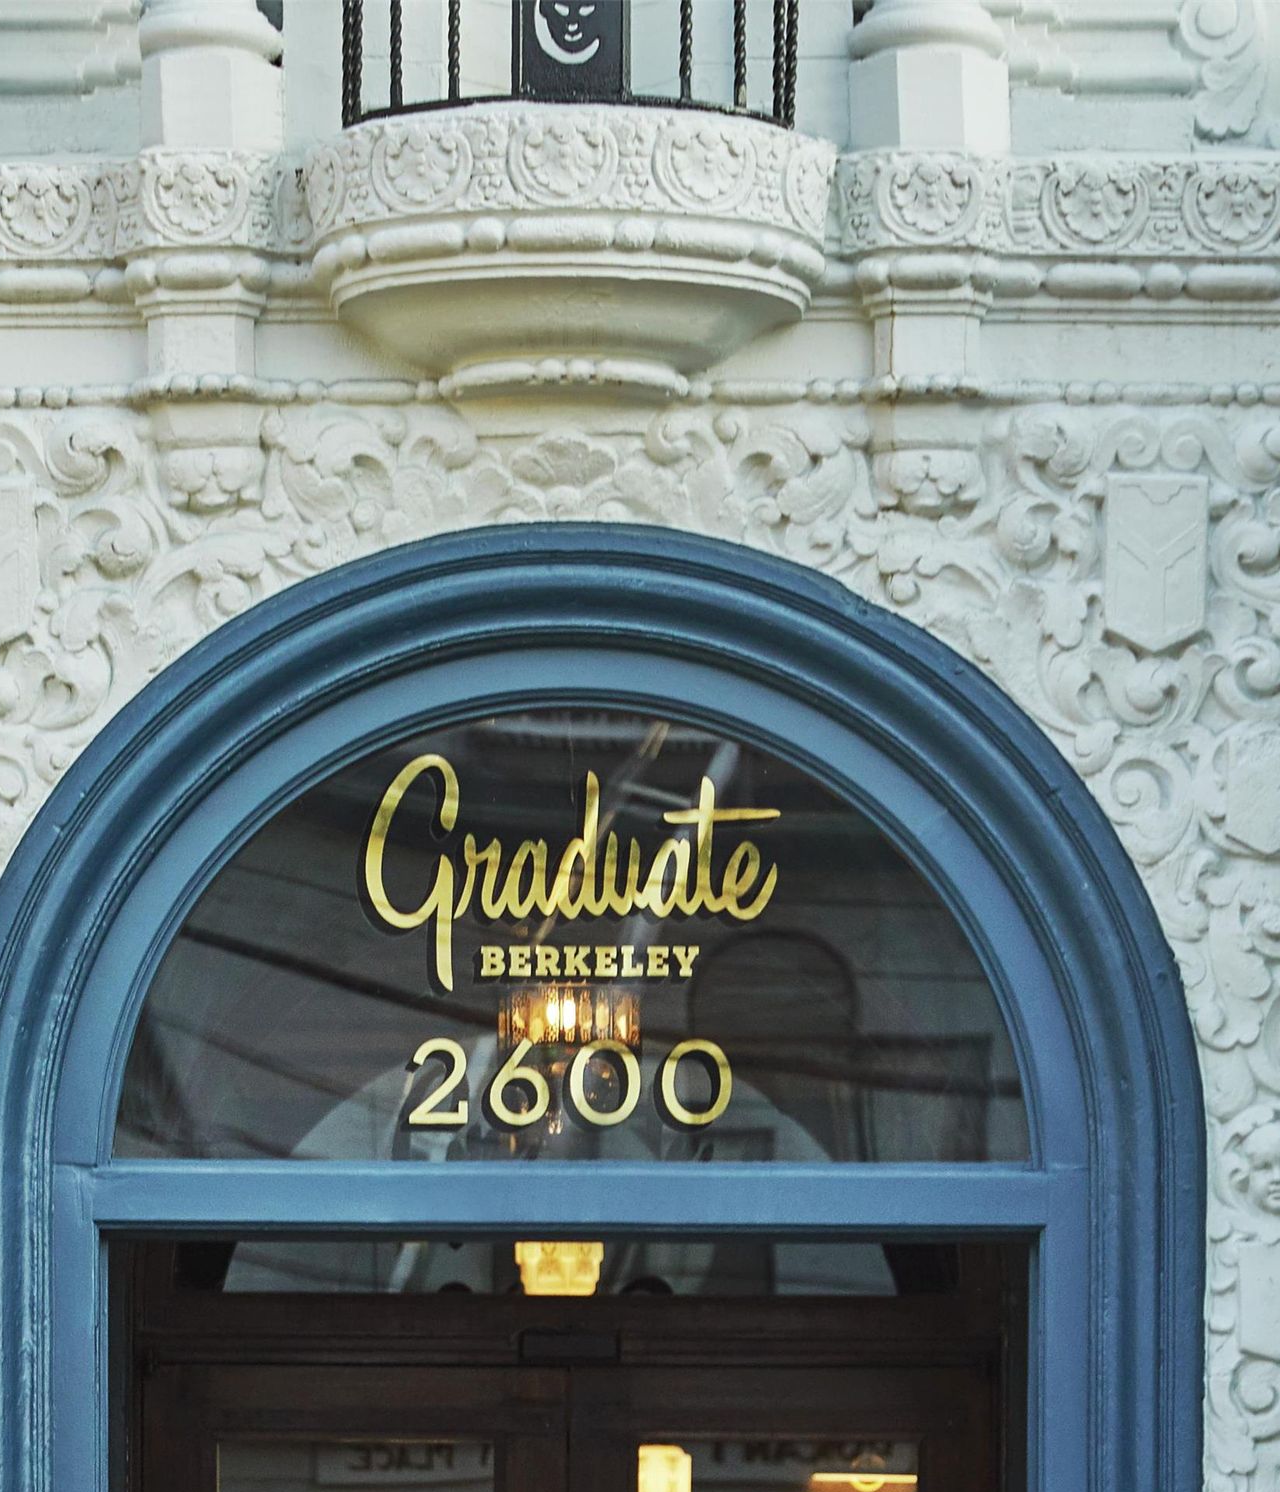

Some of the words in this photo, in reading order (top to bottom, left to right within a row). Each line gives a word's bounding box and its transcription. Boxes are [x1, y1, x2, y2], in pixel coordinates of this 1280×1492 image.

[365, 754, 781, 991] Graduate
[480, 945, 700, 977] BERKELEY
[409, 1038, 733, 1125] 2600
